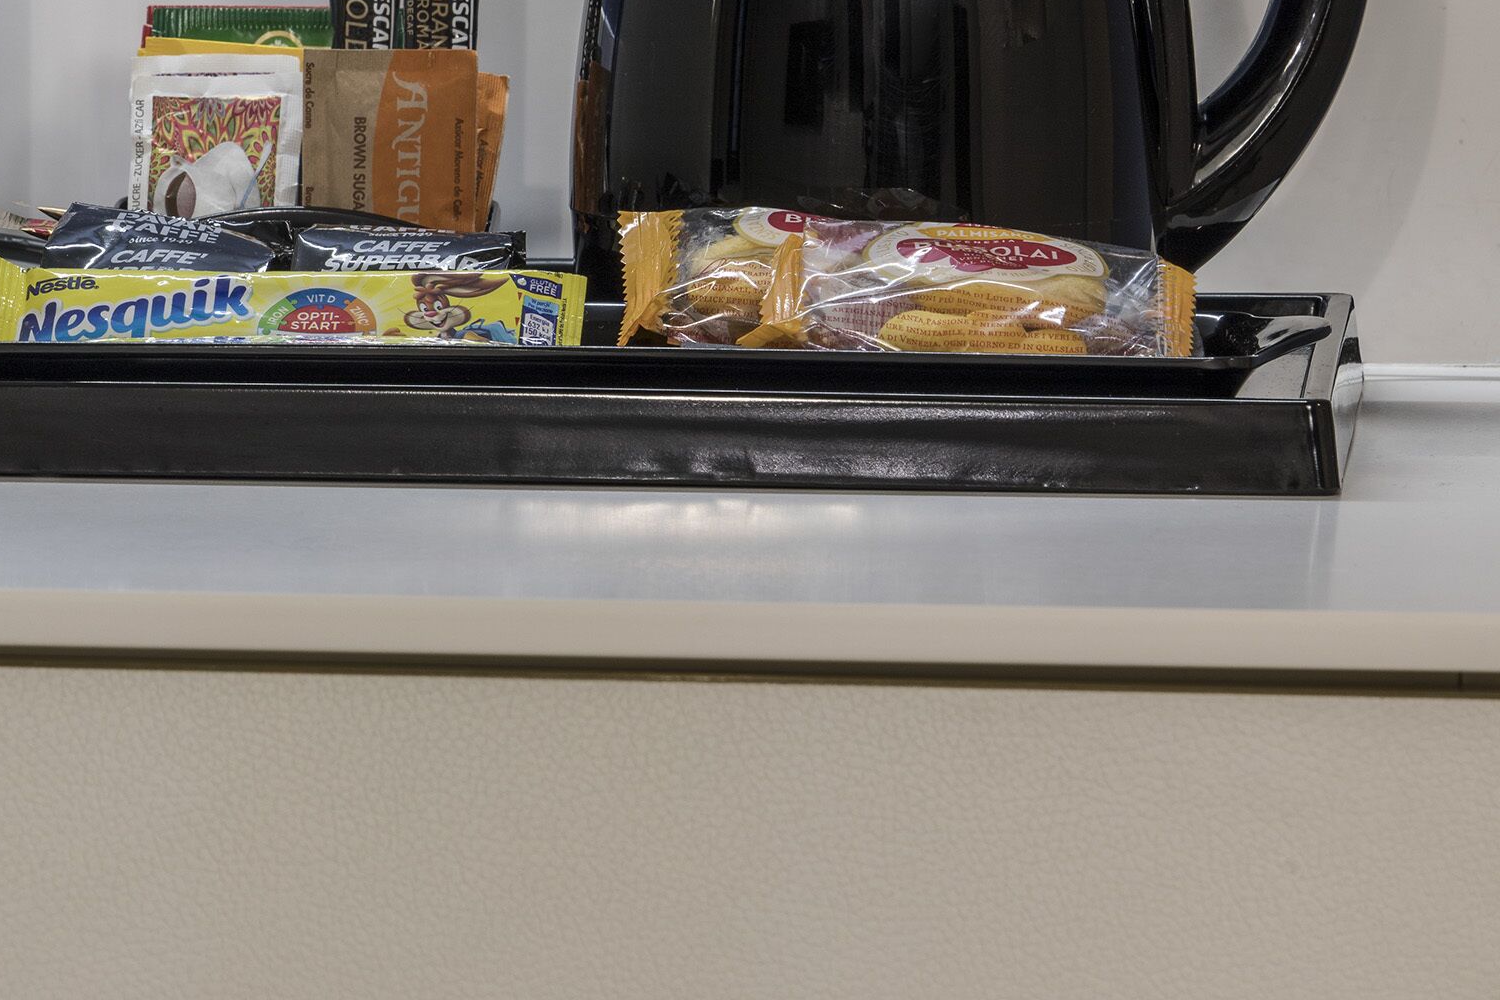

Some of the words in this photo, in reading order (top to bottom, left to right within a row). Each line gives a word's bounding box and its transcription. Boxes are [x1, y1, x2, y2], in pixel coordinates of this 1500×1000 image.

[407, 0, 415, 36] DECAF
[305, 62, 315, 86] Sucre
[305, 87, 315, 100] de
[305, 101, 315, 129] Canne
[352, 116, 366, 169] BROWN
[454, 117, 465, 150] Azúcar
[391, 71, 429, 223] ANTIGU
[133, 141, 144, 177] ZUCKER
[453, 150, 463, 184] Moreno
[352, 173, 366, 212] SUGA
[453, 185, 463, 198] de
[128, 235, 160, 245] since
[162, 236, 193, 245] 1949
[936, 229, 1035, 240] PALMISANO
[914, 241, 1059, 260] BUOLAI
[322, 253, 480, 272] SUPERBAR
[529, 284, 557, 297] FREE
[530, 278, 557, 290] GLUTEN
[306, 293, 326, 304] VIT
[326, 294, 336, 303] D
[18, 275, 251, 342] Nesquik
[267, 305, 289, 326] IRON
[297, 311, 340, 321] OPTI-
[290, 321, 340, 331] START
[524, 326, 538, 337] 150
